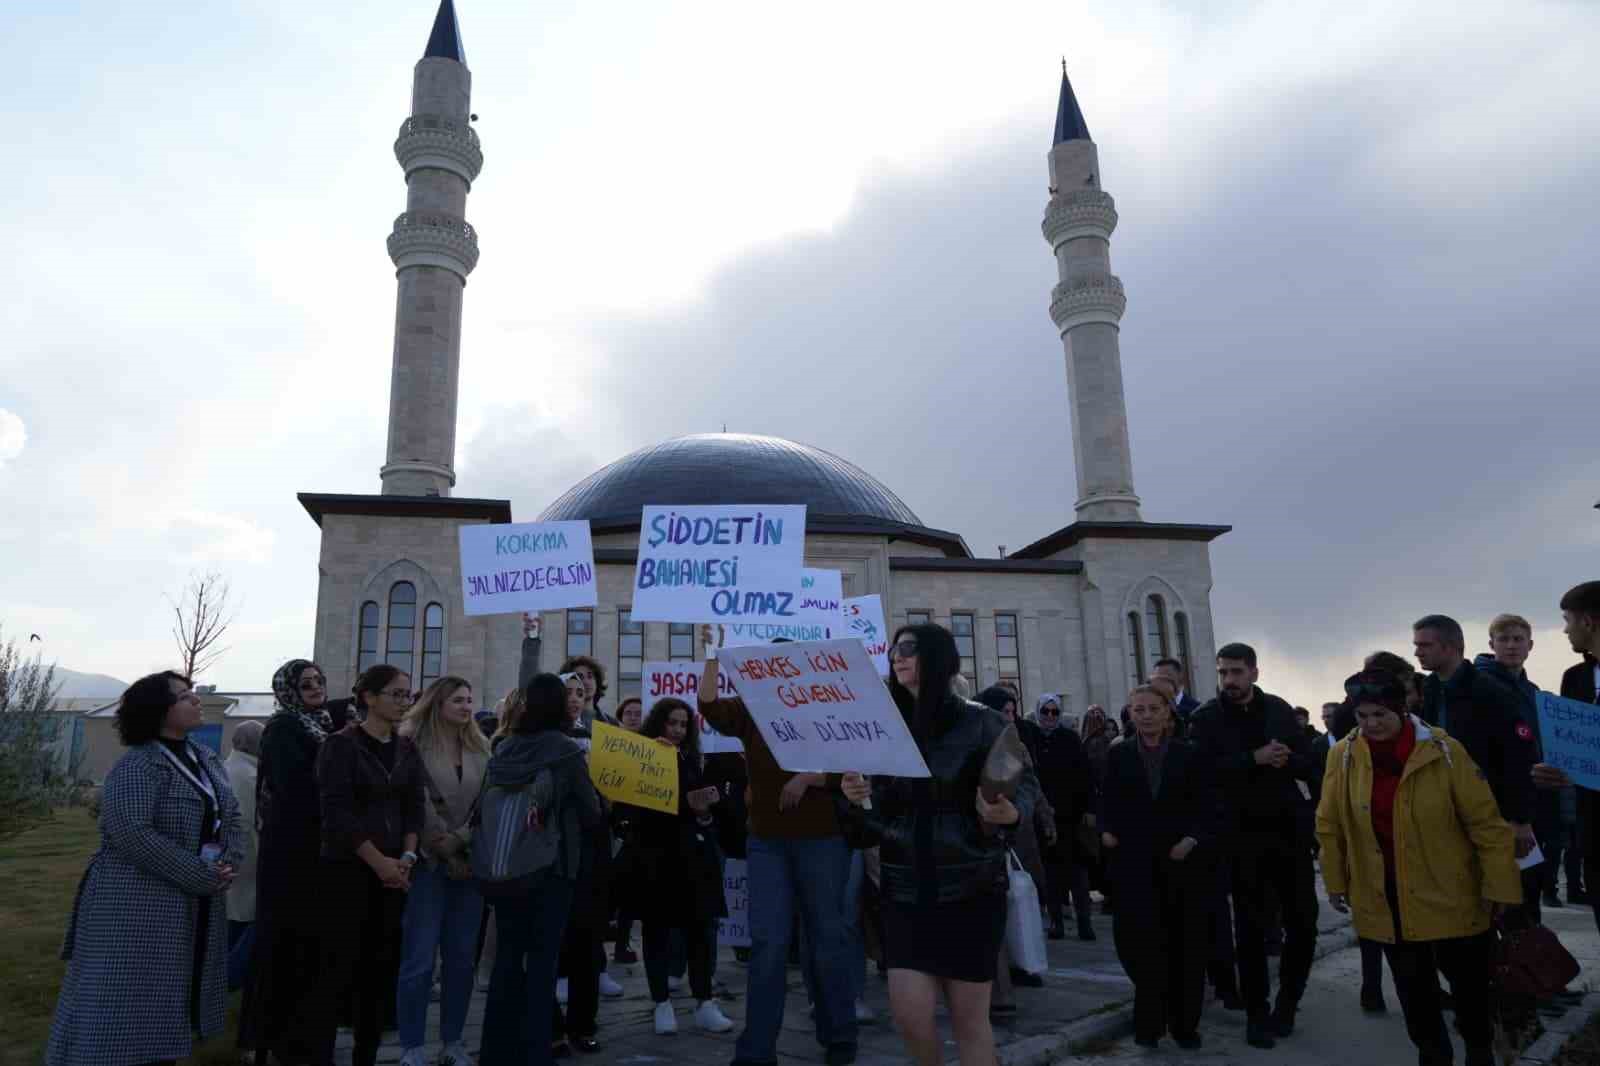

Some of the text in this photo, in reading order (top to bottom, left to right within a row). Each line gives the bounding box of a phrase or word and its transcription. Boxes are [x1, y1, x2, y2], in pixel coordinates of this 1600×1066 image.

[496, 531, 568, 554] KORKMA
[648, 512, 783, 547] ŞİDDETİN
[638, 556, 739, 589] BAHANESİ
[711, 590, 799, 616] OLMAZ
[734, 655, 801, 681] HERKES
[777, 677, 856, 708] GÜVENLİ
[770, 715, 891, 743] BİR DÜNYA
